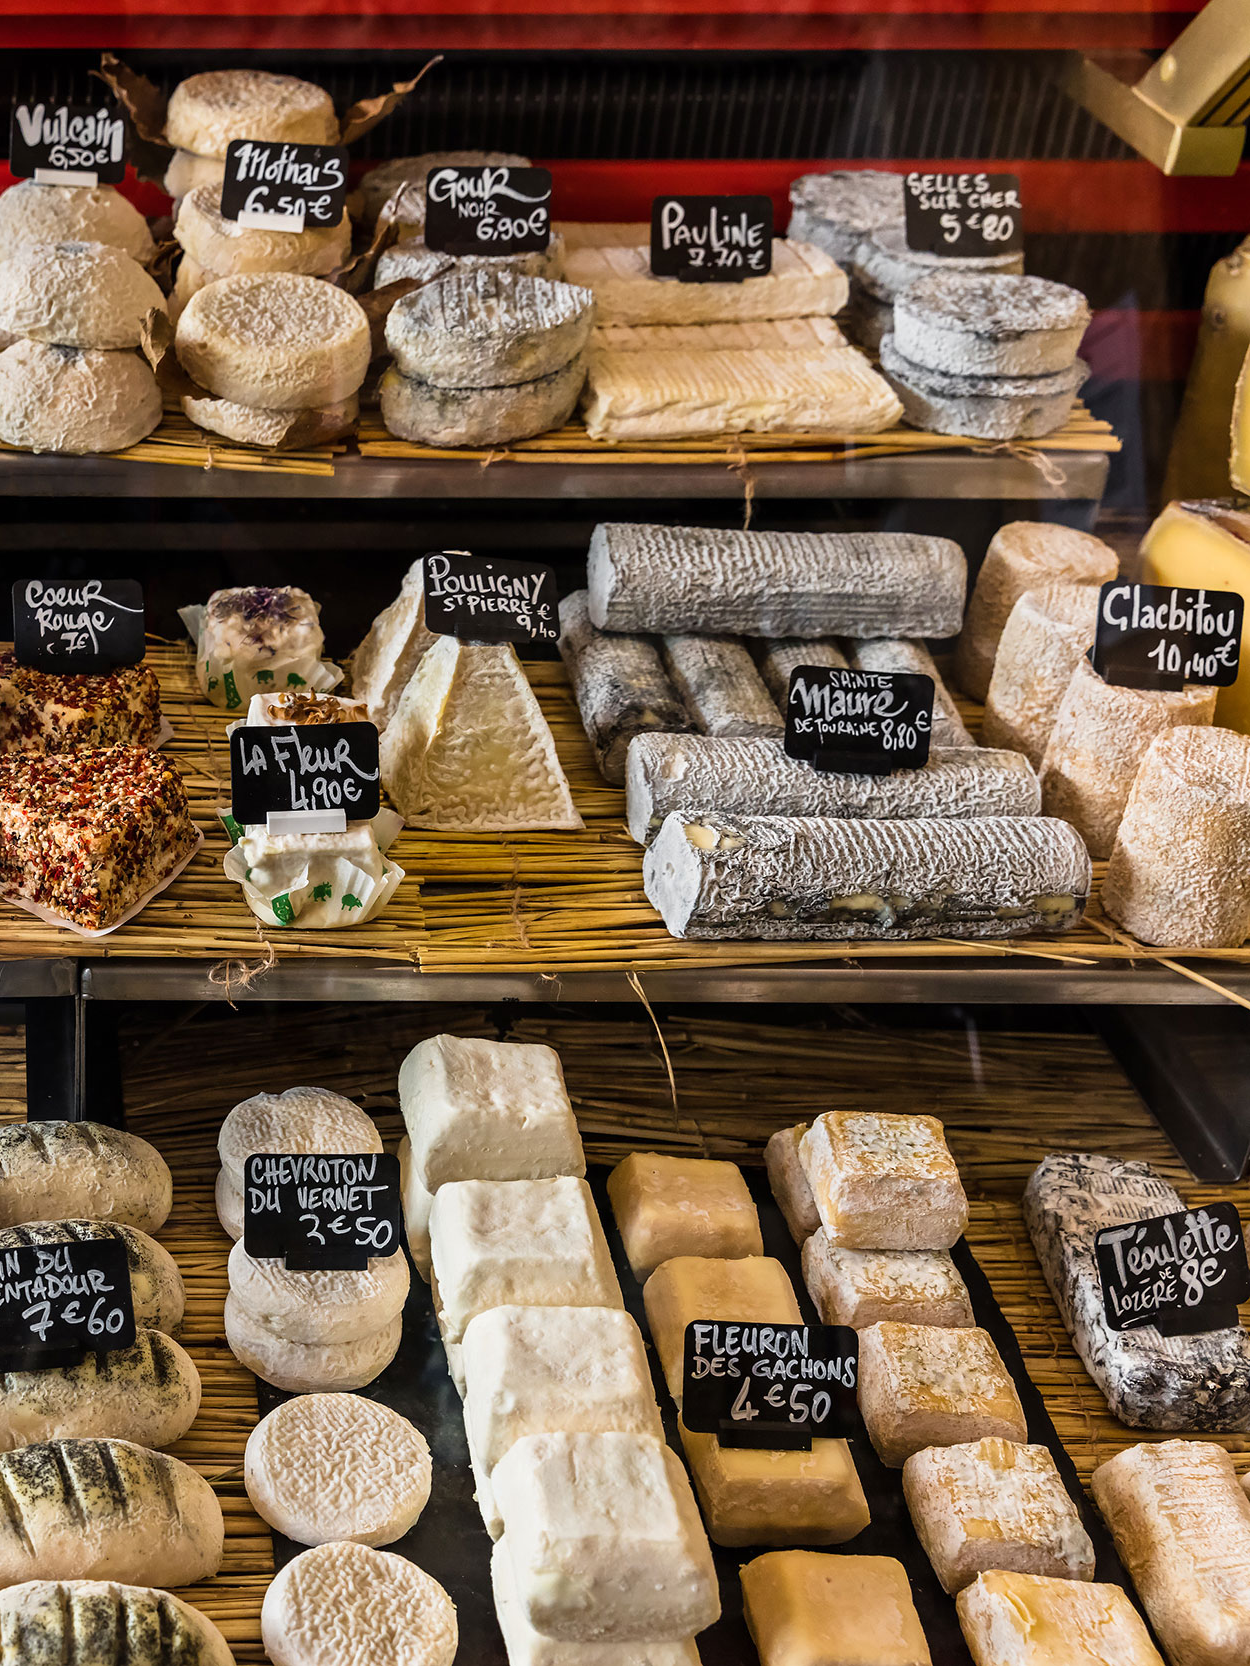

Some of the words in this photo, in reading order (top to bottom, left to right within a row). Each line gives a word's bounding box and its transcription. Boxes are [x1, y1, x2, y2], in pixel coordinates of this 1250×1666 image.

[15, 103, 124, 163] Vulcain
[48, 145, 110, 170] 6,50€
[907, 173, 989, 196] SELLES
[918, 192, 962, 210] SUR
[967, 190, 1022, 210] CHER
[476, 207, 548, 241] 6,90€
[60, 631, 91, 655] 7€
[1147, 639, 1240, 679] 10,40€
[790, 678, 909, 721] Maure
[794, 717, 816, 734] DE
[881, 709, 931, 751] 8,80€
[240, 737, 268, 775] LA
[289, 768, 363, 811] 4,90€
[250, 1154, 378, 1185] CHEVROTON
[247, 1186, 282, 1214] DU
[297, 1185, 390, 1212] VERNET
[35, 1247, 74, 1274] DU
[1158, 1266, 1175, 1281] DE
[1179, 1257, 1227, 1308] 8€
[693, 1323, 810, 1358] FLEURON
[691, 1355, 742, 1380] DES
[751, 1355, 857, 1388] GACHONS
